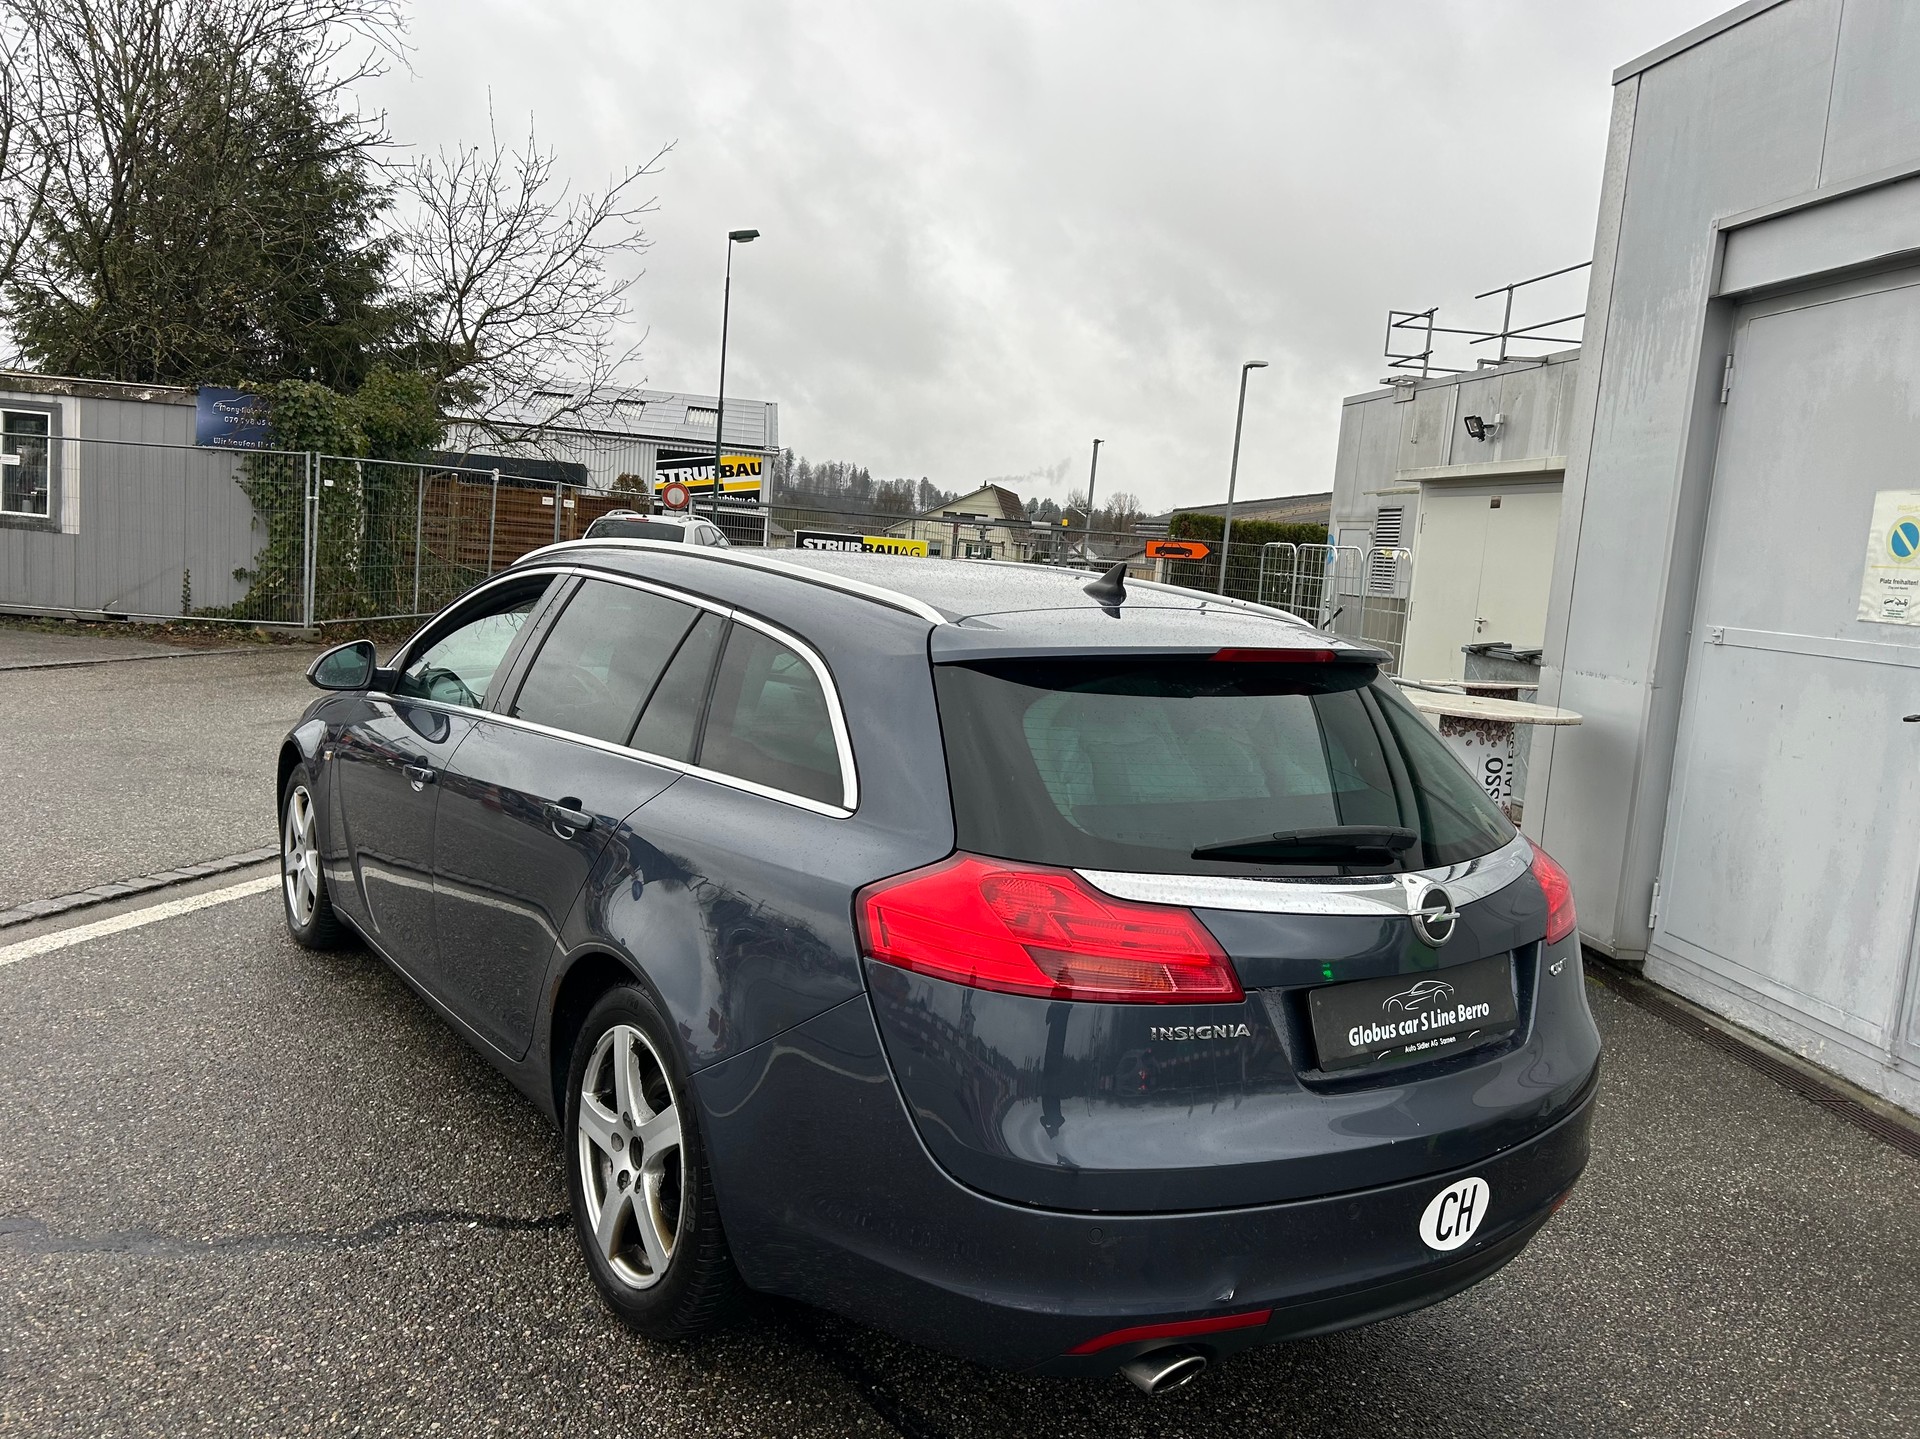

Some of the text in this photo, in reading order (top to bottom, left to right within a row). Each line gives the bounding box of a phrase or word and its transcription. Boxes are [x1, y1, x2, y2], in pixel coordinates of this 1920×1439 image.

[224, 416, 239, 424] 079
[655, 461, 762, 483] STRUBBAU
[1149, 1023, 1251, 1041] INSIGNIA
[1348, 1002, 1490, 1047] Globus car S Line Berro
[1404, 1044, 1417, 1053] Auto
[1430, 1039, 1439, 1048] AG
[1436, 1184, 1478, 1242] CH
